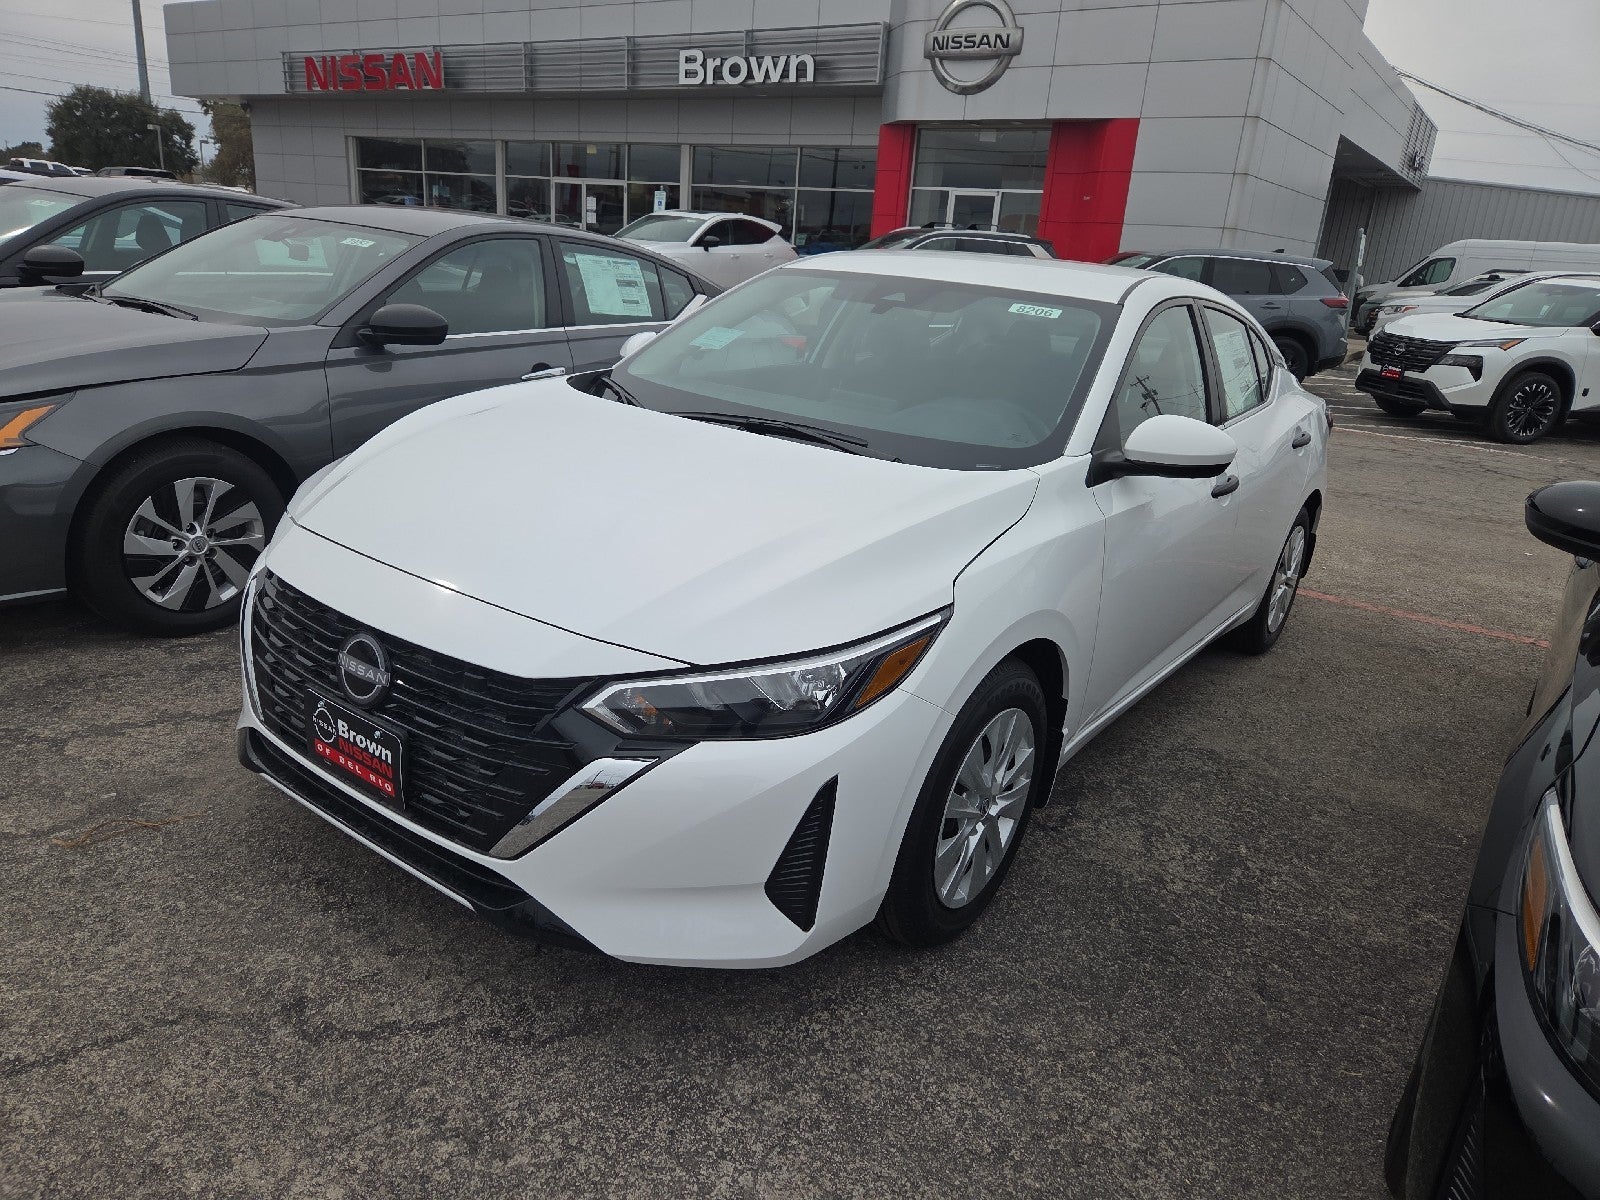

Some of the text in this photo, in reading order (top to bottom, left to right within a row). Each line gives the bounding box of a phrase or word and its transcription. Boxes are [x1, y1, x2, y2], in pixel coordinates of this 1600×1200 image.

[932, 33, 1010, 51] NISSAN
[304, 51, 444, 91] NISSAN
[678, 48, 815, 85] Brown
[1016, 305, 1054, 317] 8206
[338, 651, 387, 685] NISSAN
[312, 715, 337, 738] NISSAN
[337, 718, 392, 764] Brown
[316, 743, 392, 792] OF DEL RIO
[338, 737, 393, 779] NISSAN
